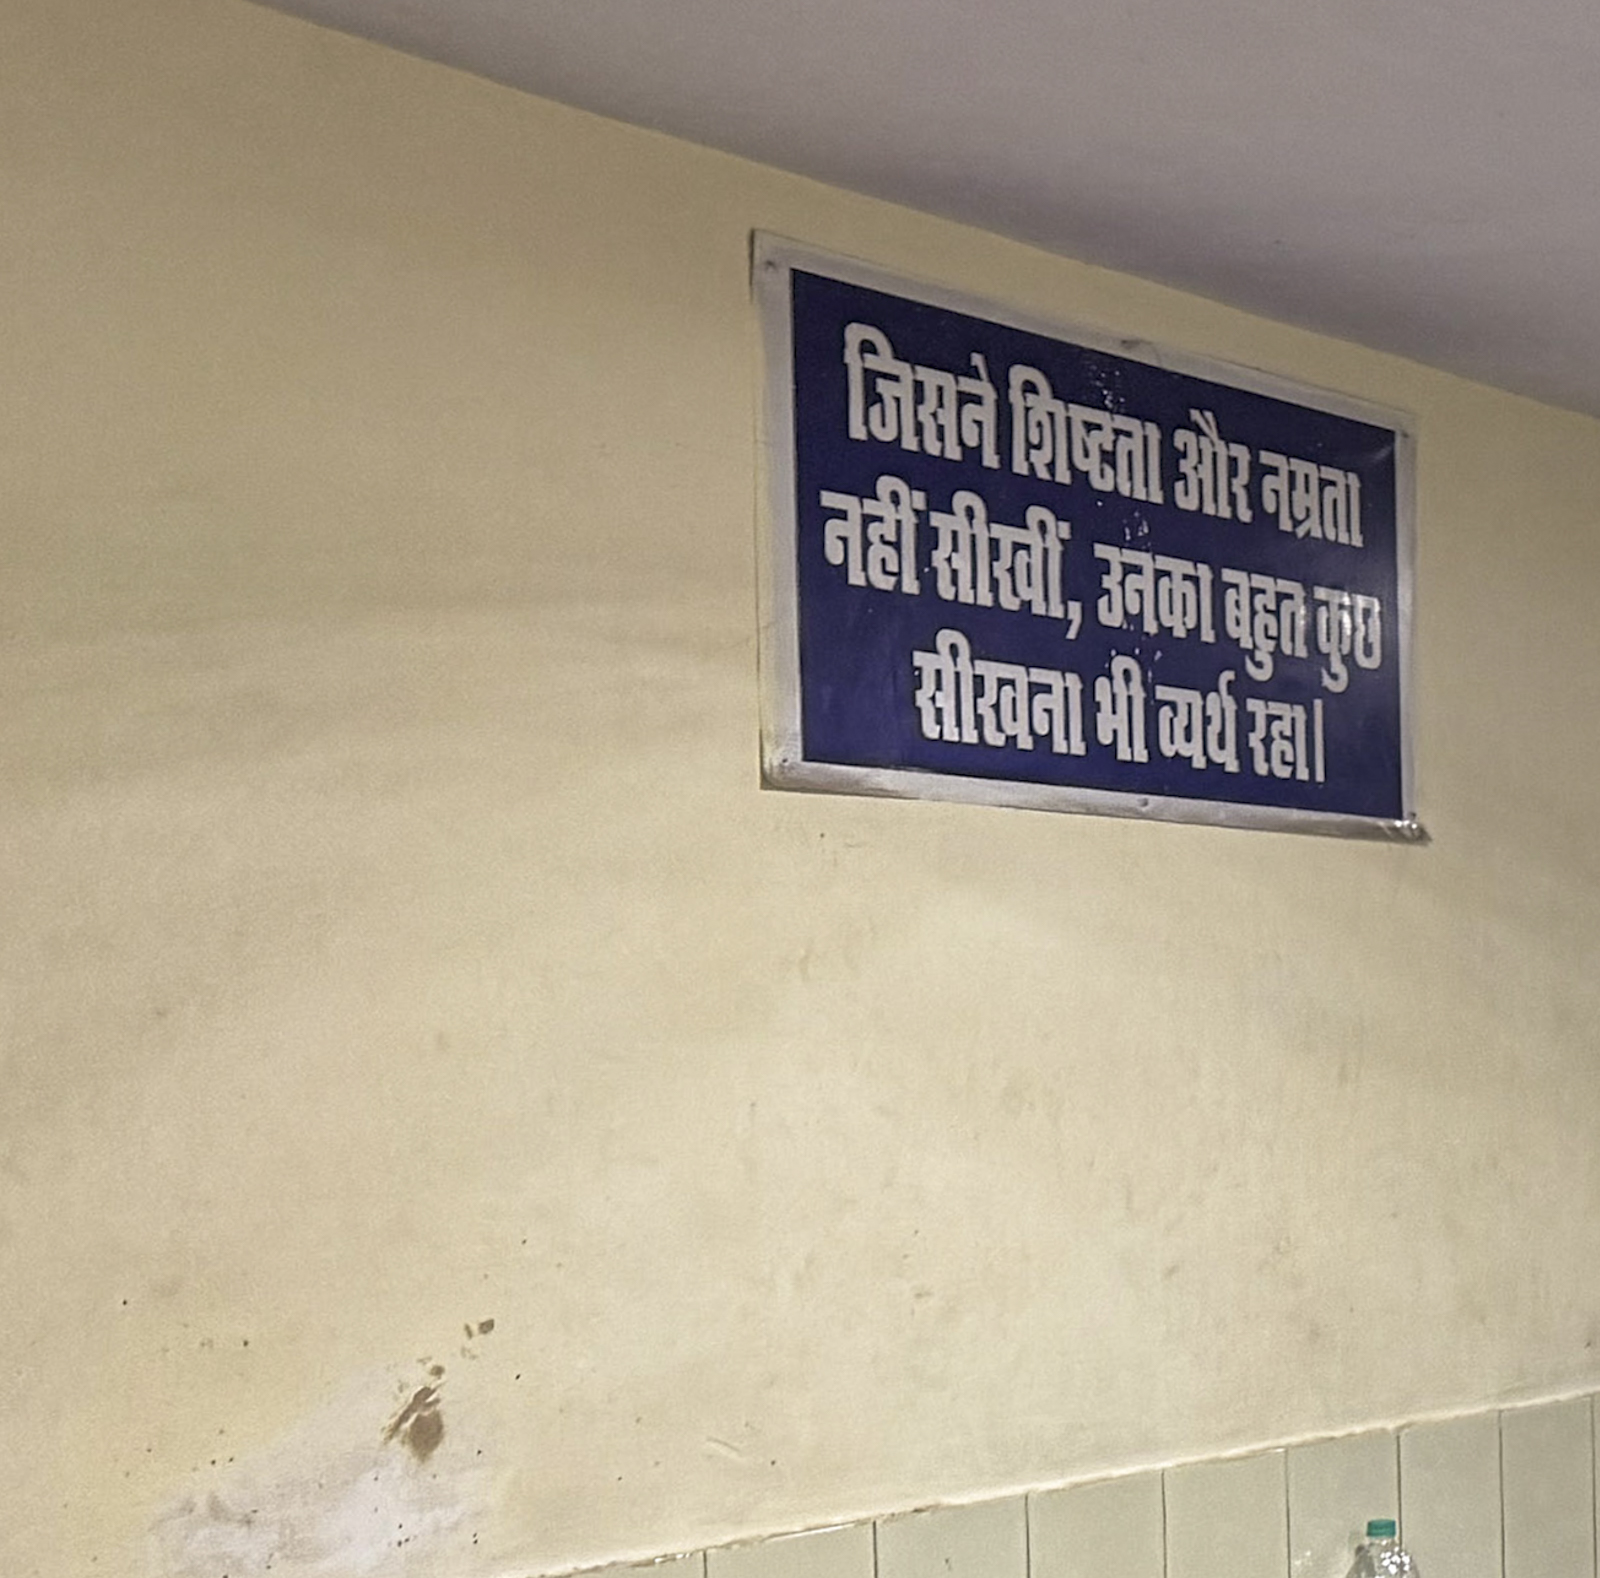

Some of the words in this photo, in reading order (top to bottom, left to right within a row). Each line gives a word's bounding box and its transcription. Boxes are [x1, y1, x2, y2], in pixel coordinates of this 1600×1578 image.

[843, 322, 1000, 469] जिसने
[1009, 364, 1165, 504] शिष्टता
[1173, 408, 1253, 523] और
[1258, 449, 1364, 549] नम्रता
[819, 475, 927, 595] नहीं
[929, 490, 1083, 641] सीखीं,
[1093, 542, 1216, 644] उनका
[1221, 568, 1311, 682] बहुत
[1313, 584, 1382, 693] कुछ
[912, 628, 1086, 756] सीखना
[1094, 655, 1149, 763] भी
[1155, 670, 1240, 773] व्यर्थ
[1246, 697, 1326, 783] रहा।
